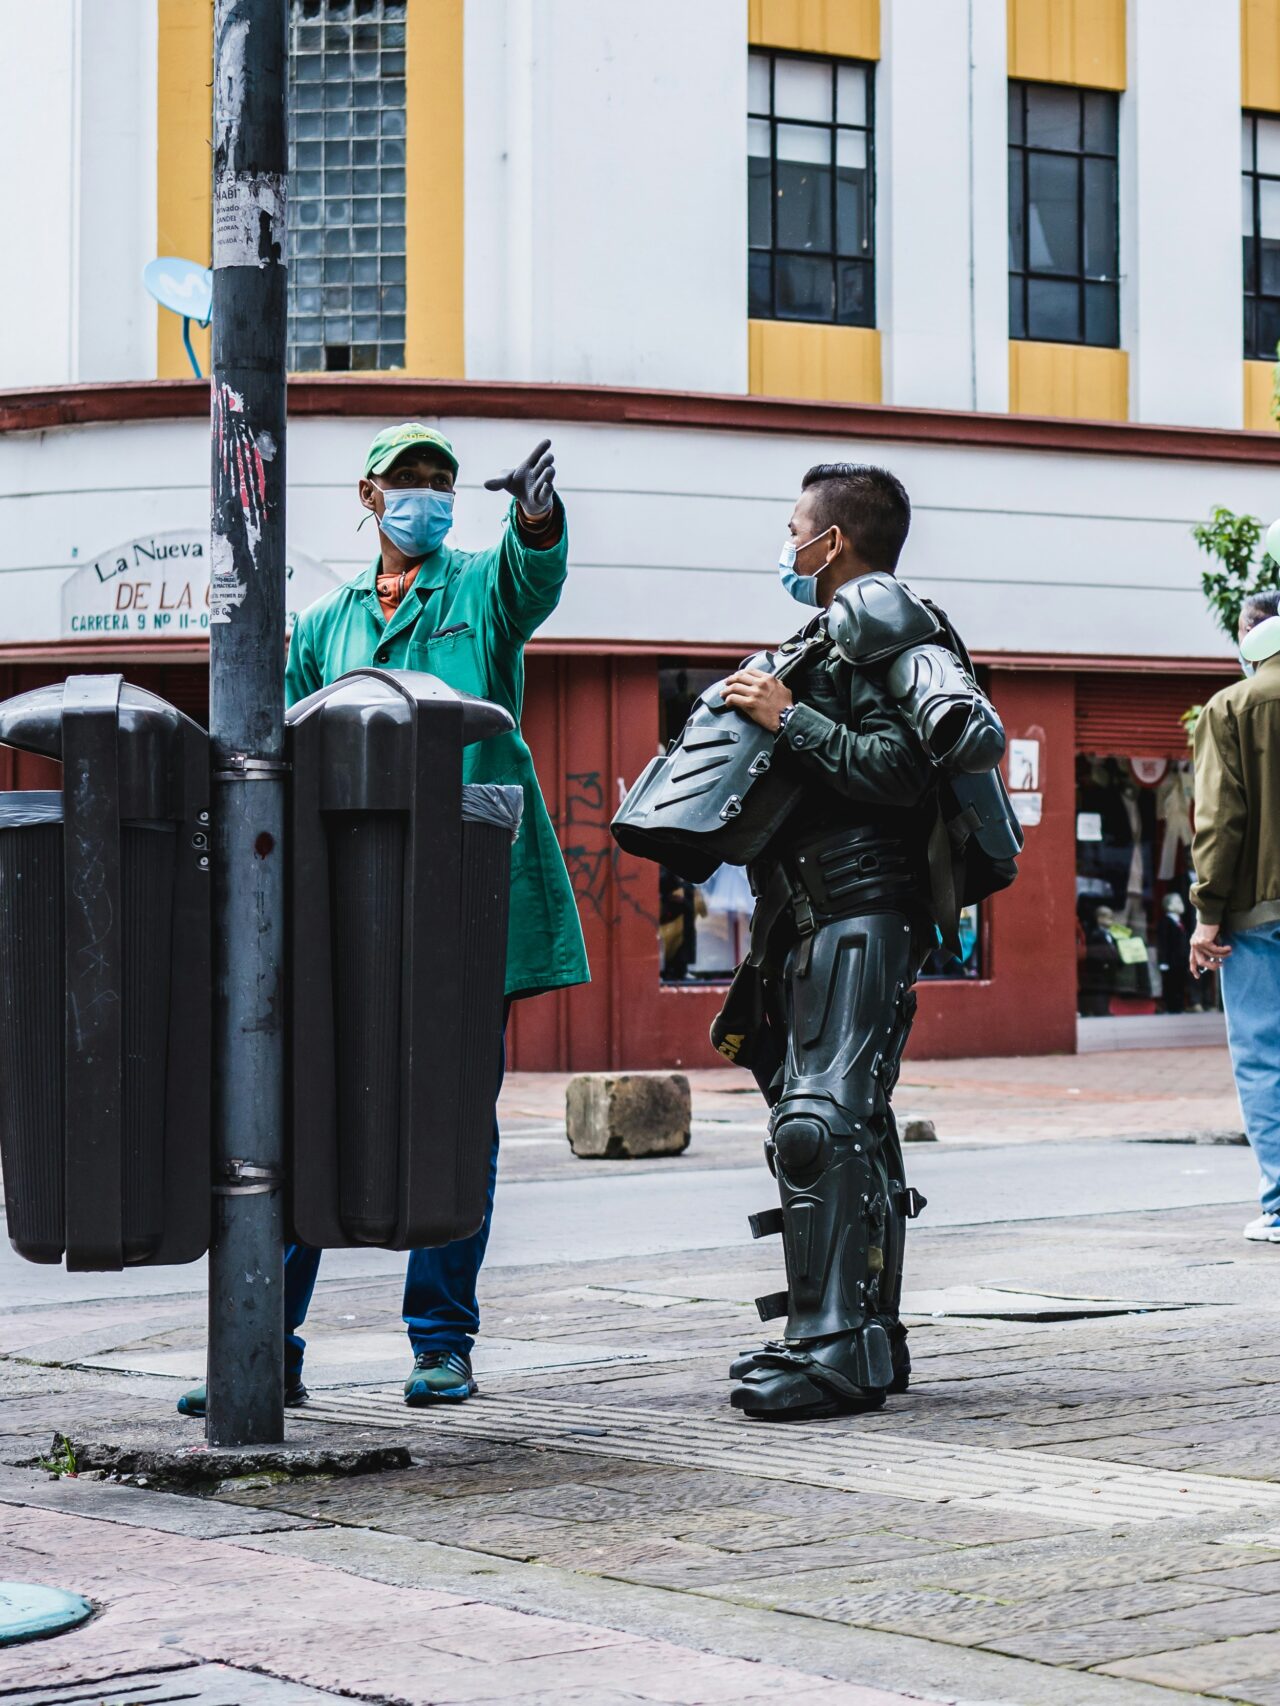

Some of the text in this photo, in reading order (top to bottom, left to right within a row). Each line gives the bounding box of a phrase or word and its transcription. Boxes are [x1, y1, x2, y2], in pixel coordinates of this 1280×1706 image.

[216, 188, 241, 201] HABI
[94, 539, 204, 583] La Nueva
[115, 581, 152, 611] DE
[158, 581, 193, 611] LA
[71, 613, 129, 631] CARRERA
[137, 613, 146, 630] 9
